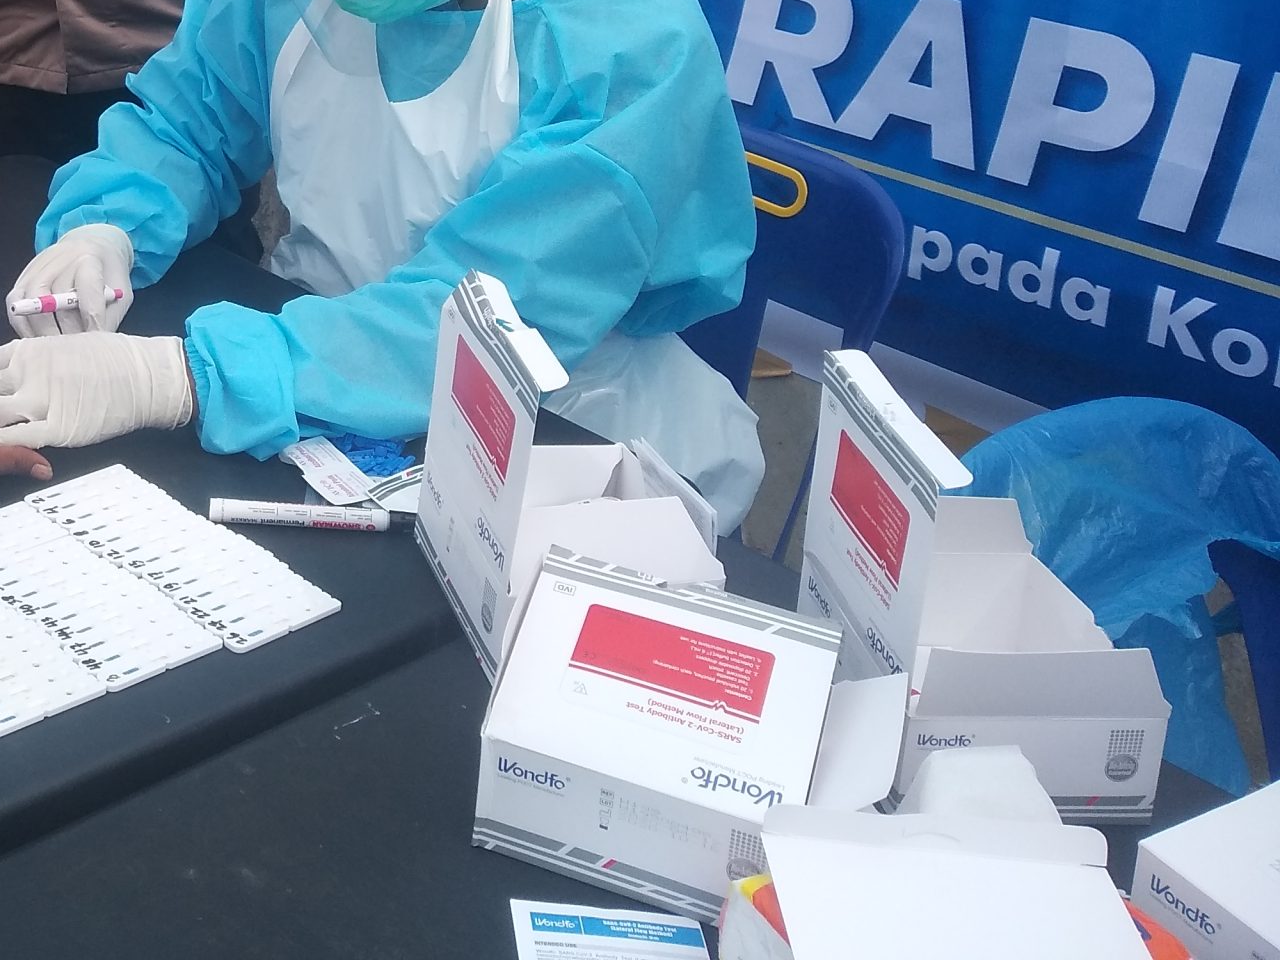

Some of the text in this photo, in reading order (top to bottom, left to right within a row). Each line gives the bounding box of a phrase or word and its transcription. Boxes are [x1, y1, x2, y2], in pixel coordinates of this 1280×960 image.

[906, 225, 1111, 329] pada
[107, 549, 124, 559] 12
[476, 516, 505, 573] Wondfo
[147, 572, 165, 580] 17
[163, 583, 182, 591] 19
[179, 596, 197, 604] 21
[808, 576, 832, 618] Wondfo
[626, 701, 743, 744] SARS-CoV-2 Antibody Test
[647, 699, 744, 734] (Lateral Flow Method)
[918, 734, 971, 747] Wondfo
[498, 756, 565, 790] Wondfo
[691, 767, 783, 808] Wondfo
[1150, 873, 1216, 935] Wondfo
[534, 917, 576, 929] Wondfo
